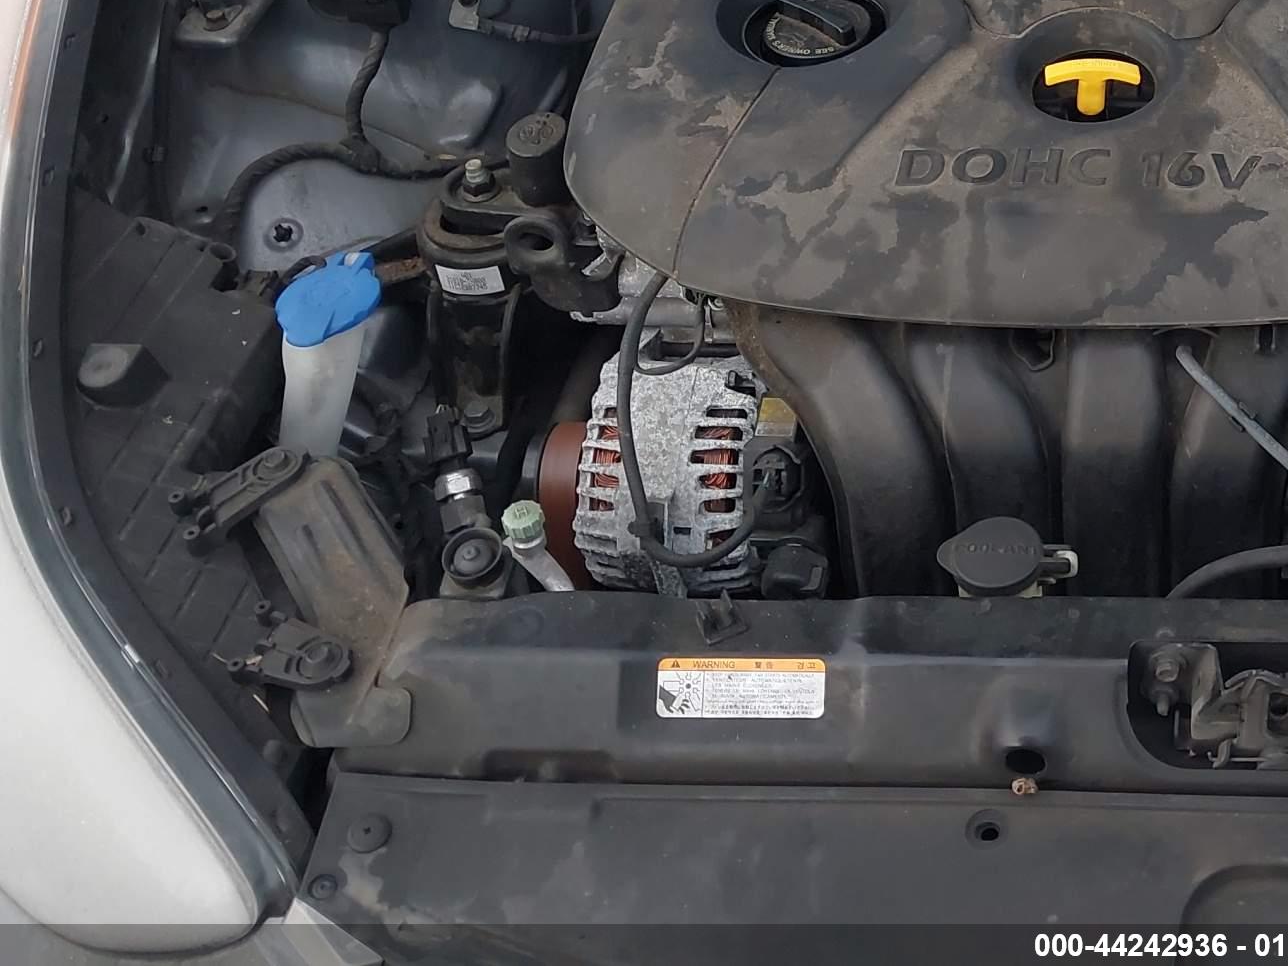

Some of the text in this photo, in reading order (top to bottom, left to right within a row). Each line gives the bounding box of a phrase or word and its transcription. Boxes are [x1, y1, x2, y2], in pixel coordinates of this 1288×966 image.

[895, 147, 1262, 190] DOHC 16V
[692, 660, 736, 669] WARNING
